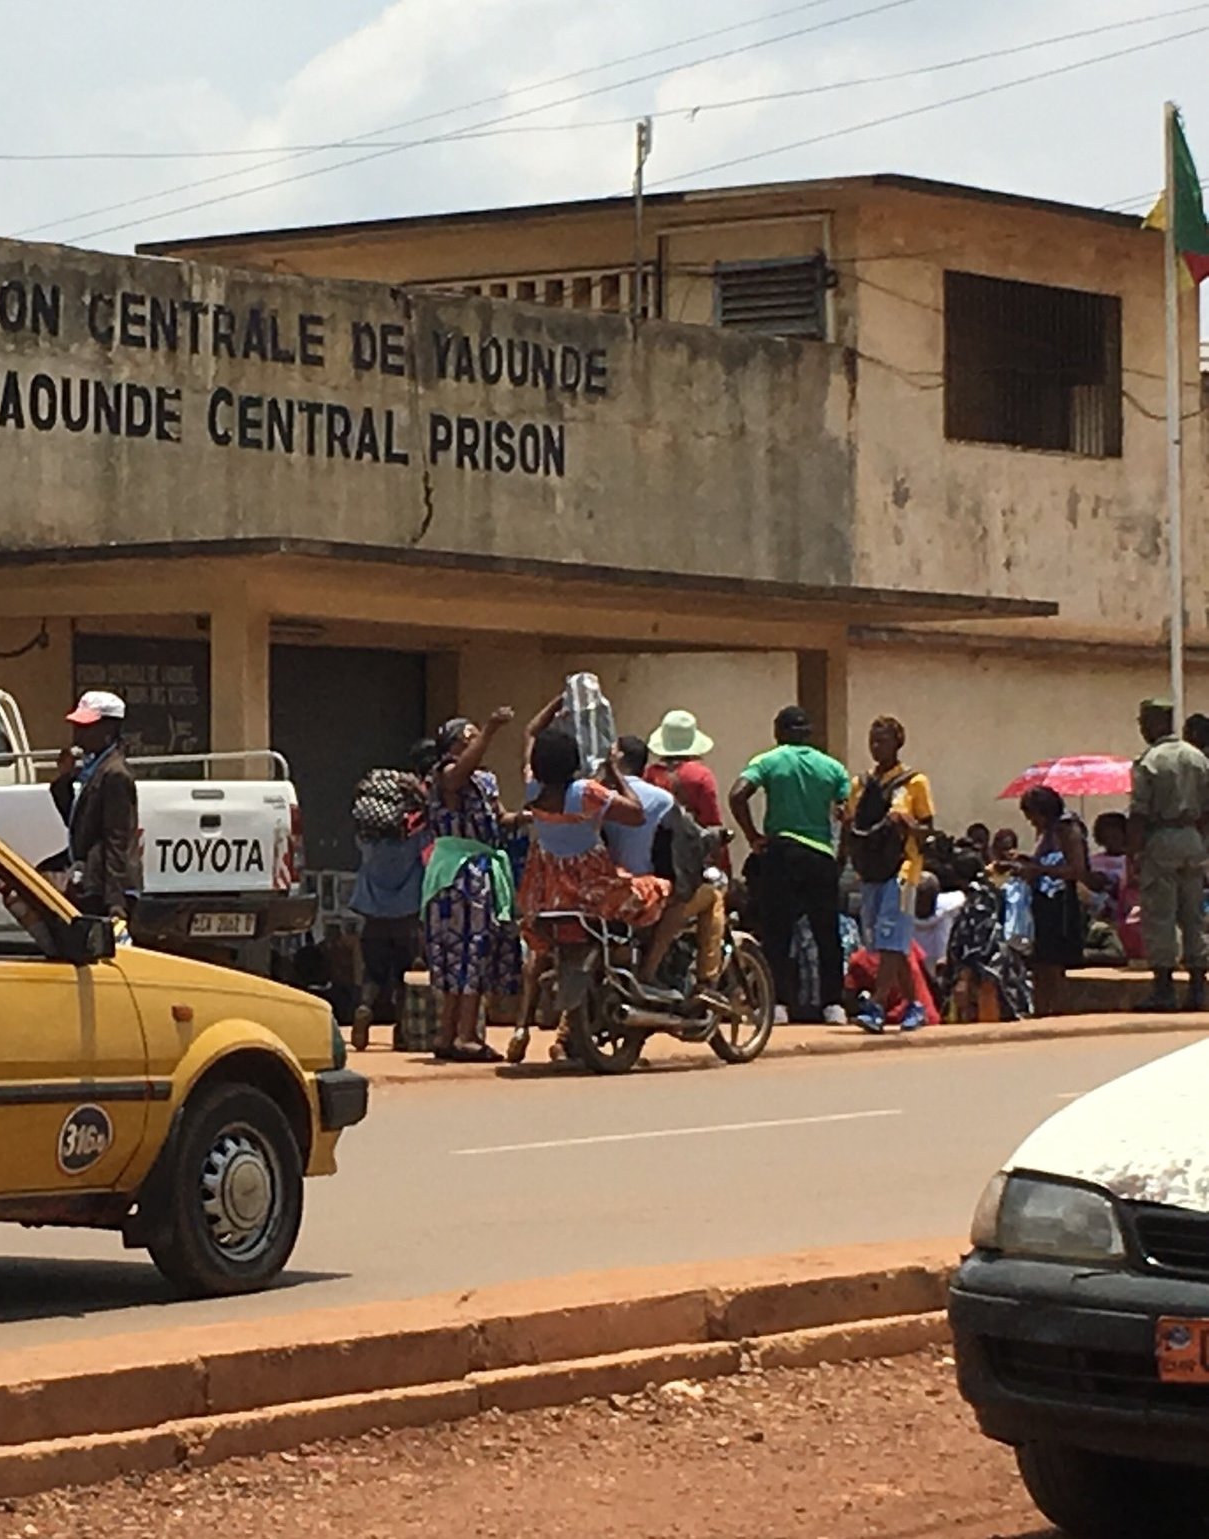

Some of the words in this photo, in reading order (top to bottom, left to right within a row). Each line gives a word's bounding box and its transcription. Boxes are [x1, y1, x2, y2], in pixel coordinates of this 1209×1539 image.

[88, 291, 325, 366] CENTRALE
[351, 320, 406, 377] DE
[432, 329, 608, 396] YAOUNDE
[207, 386, 410, 467] CENTRAL
[429, 412, 566, 478] PRISON
[155, 838, 264, 873] TOYOTA
